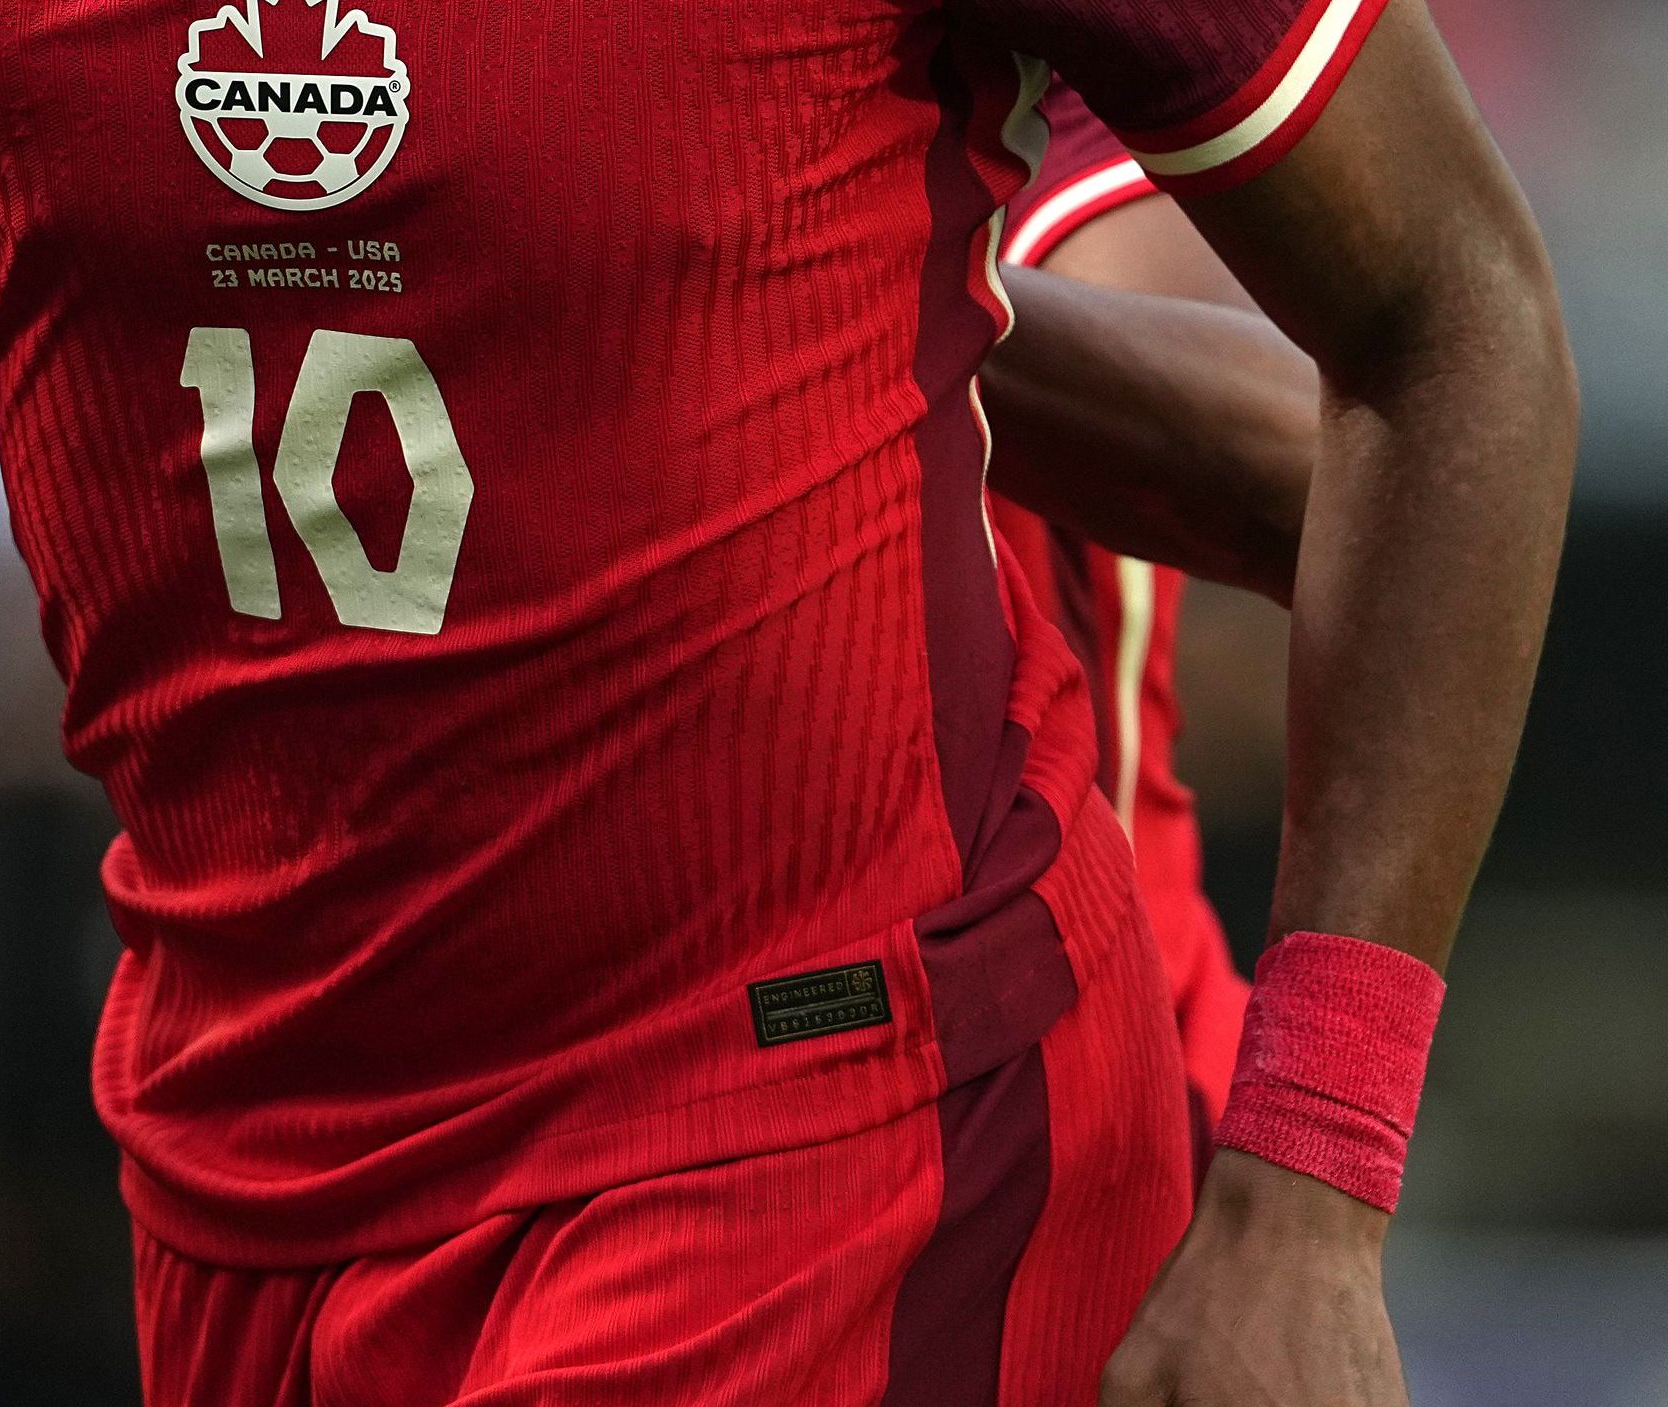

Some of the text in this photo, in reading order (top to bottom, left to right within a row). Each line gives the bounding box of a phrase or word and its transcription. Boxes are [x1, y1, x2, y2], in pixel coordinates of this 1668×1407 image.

[205, 242, 316, 262] CANADA
[347, 240, 401, 262] USA
[211, 268, 403, 293] 23 MARCH 2025
[179, 326, 475, 636] 10
[763, 981, 845, 1005] ENGINEERED
